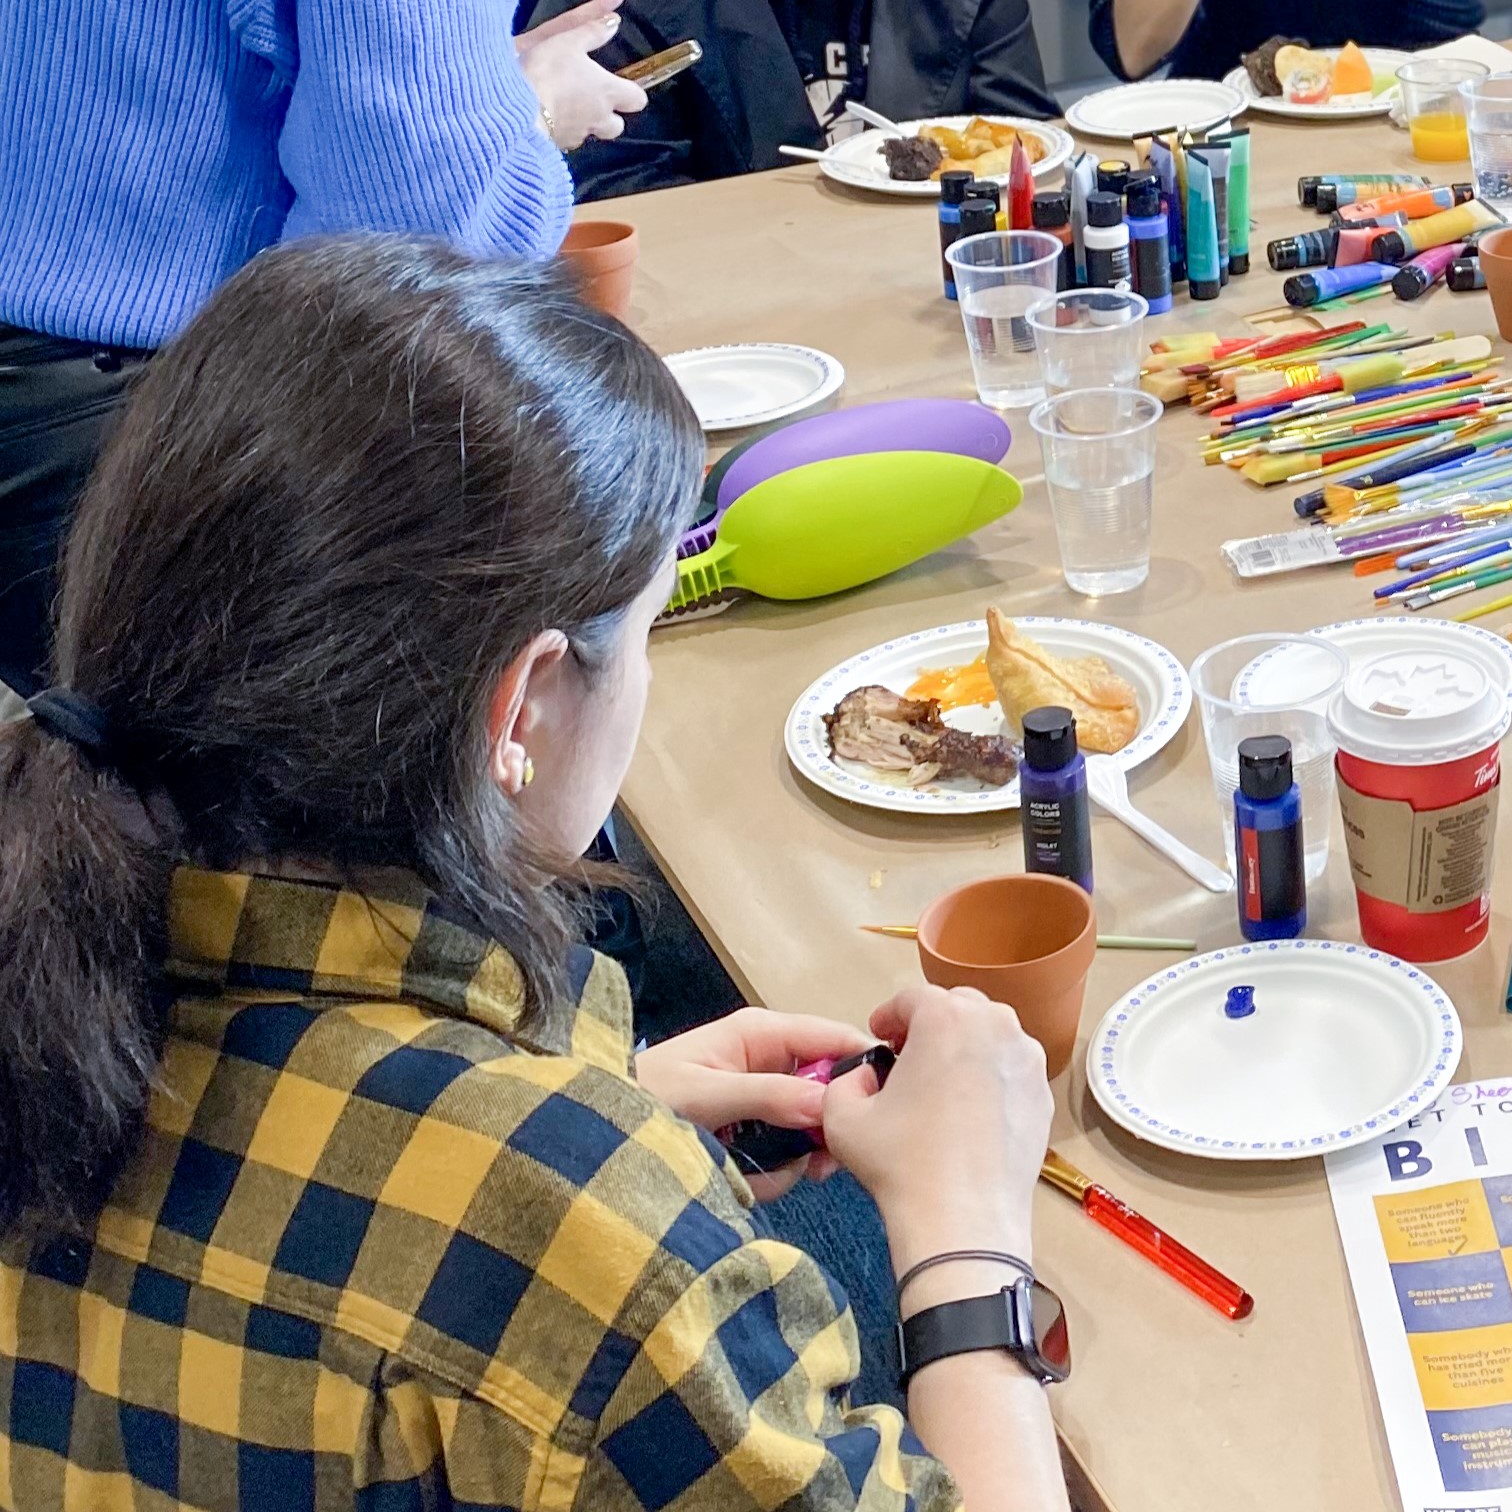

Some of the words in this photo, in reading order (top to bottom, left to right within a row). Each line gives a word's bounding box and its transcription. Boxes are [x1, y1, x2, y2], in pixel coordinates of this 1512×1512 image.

[1030, 802, 1060, 810] ACRYLIC
[1387, 1203, 1442, 1216] Someone
[1420, 1207, 1465, 1220] fluently
[1400, 1221, 1433, 1233] speak
[1436, 1216, 1467, 1226] more
[1409, 1230, 1436, 1239] than
[1408, 1286, 1465, 1298] Someone
[1460, 1291, 1493, 1301] skate
[1422, 1351, 1489, 1363] Somebody
[1453, 1360, 1482, 1369] tried
[1448, 1371, 1477, 1380] than
[1480, 1367, 1503, 1376] five
[1452, 1377, 1505, 1389] cuisines
[1441, 1427, 1511, 1442] Somebody
